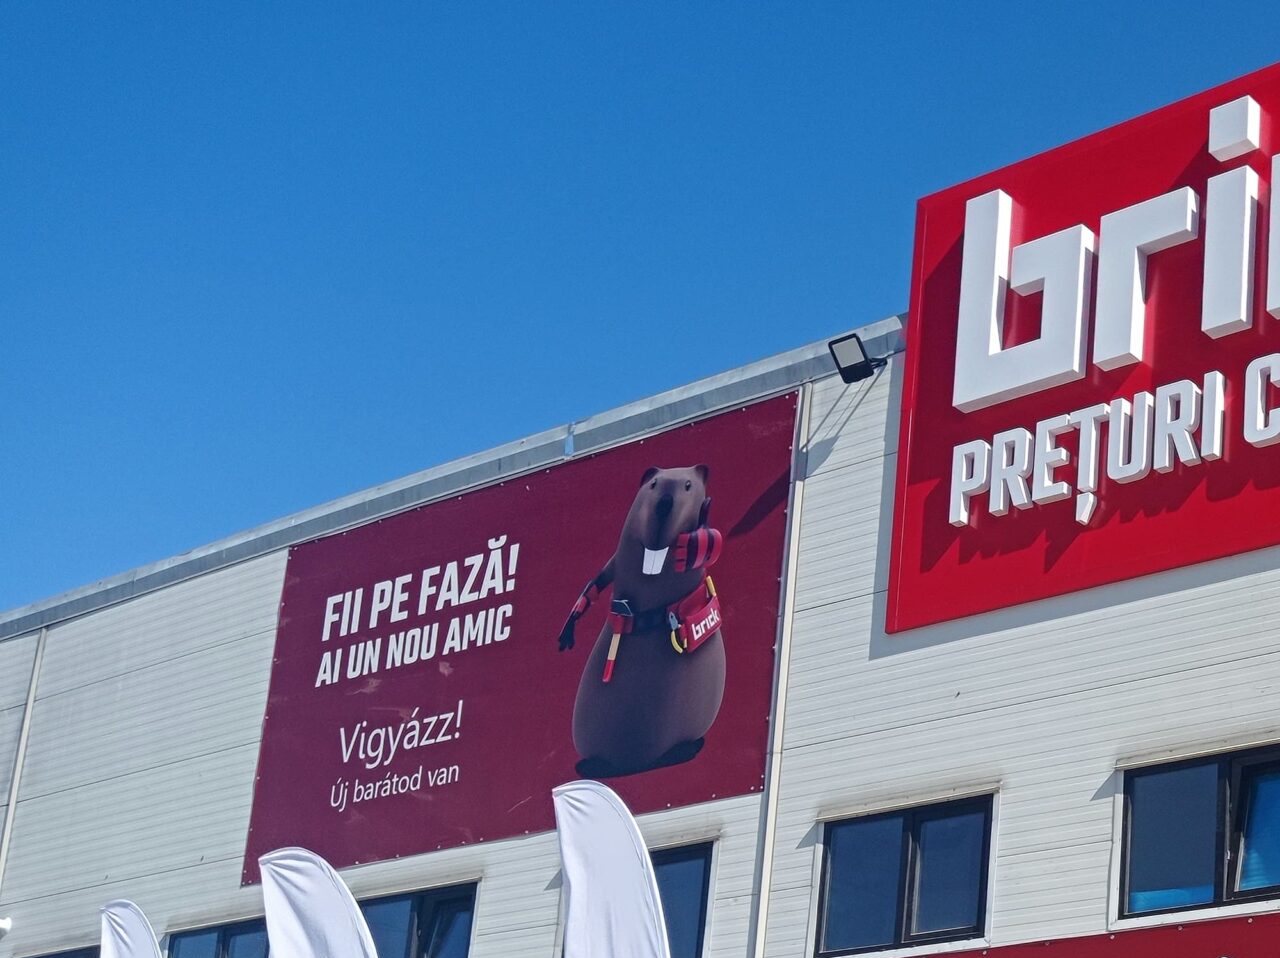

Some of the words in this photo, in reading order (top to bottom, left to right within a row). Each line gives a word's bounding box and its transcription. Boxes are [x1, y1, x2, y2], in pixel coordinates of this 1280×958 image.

[321, 587, 364, 642] FII
[368, 573, 413, 629] PE
[417, 534, 520, 617] FAZĂ!
[314, 648, 342, 688] AI
[346, 638, 382, 680] UN
[385, 622, 440, 670] NOU
[442, 603, 513, 656] AMIC
[339, 699, 464, 770] Vigyázz!
[330, 777, 348, 813] Új
[352, 765, 423, 803] barátod
[427, 764, 460, 788] van
